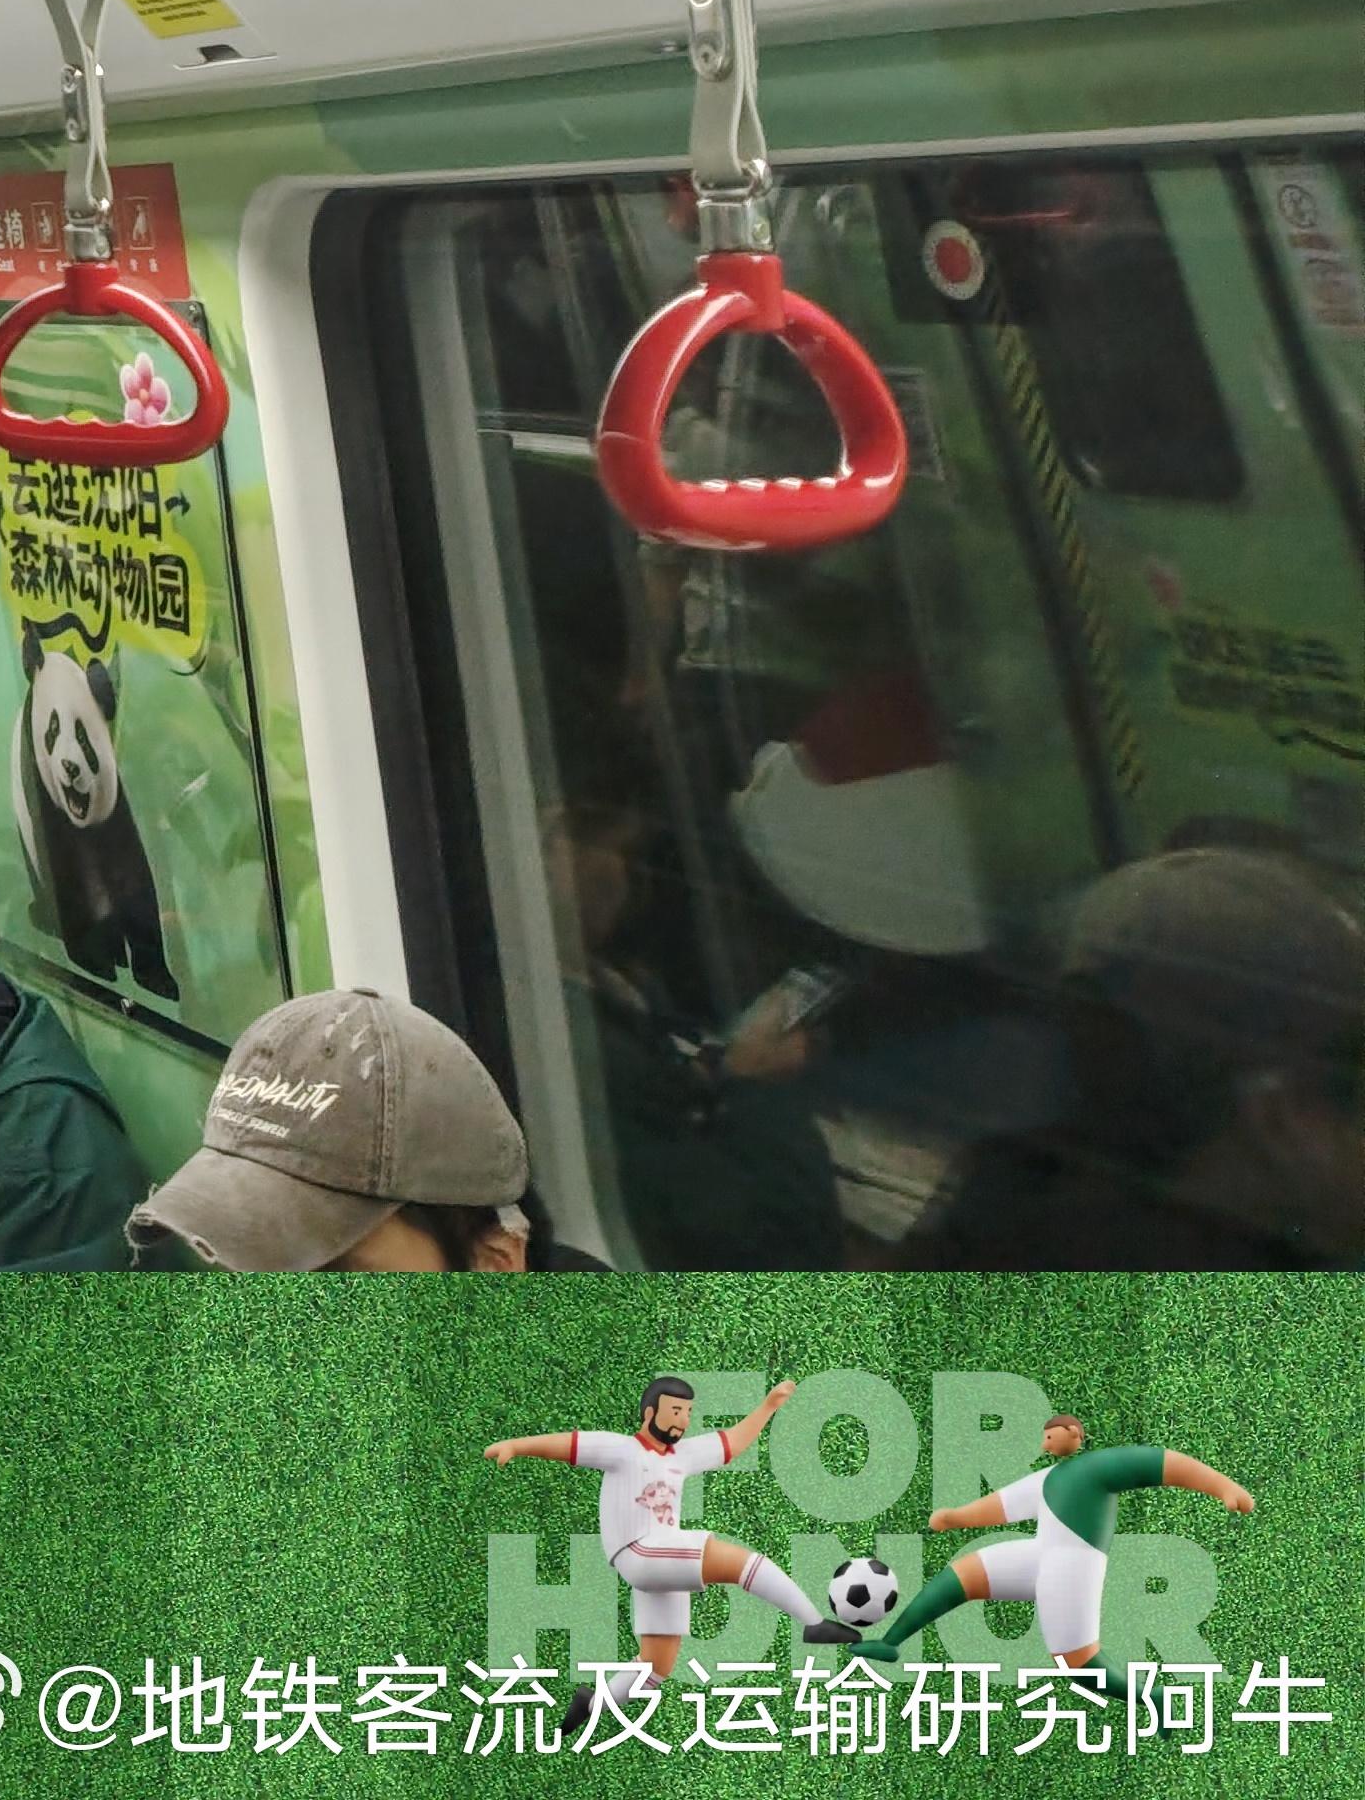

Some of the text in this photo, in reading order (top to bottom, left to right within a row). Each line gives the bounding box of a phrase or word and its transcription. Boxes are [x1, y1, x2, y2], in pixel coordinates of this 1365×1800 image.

[8, 450, 162, 541] 去逛沈阳
[10, 527, 191, 636] 森林动物园
